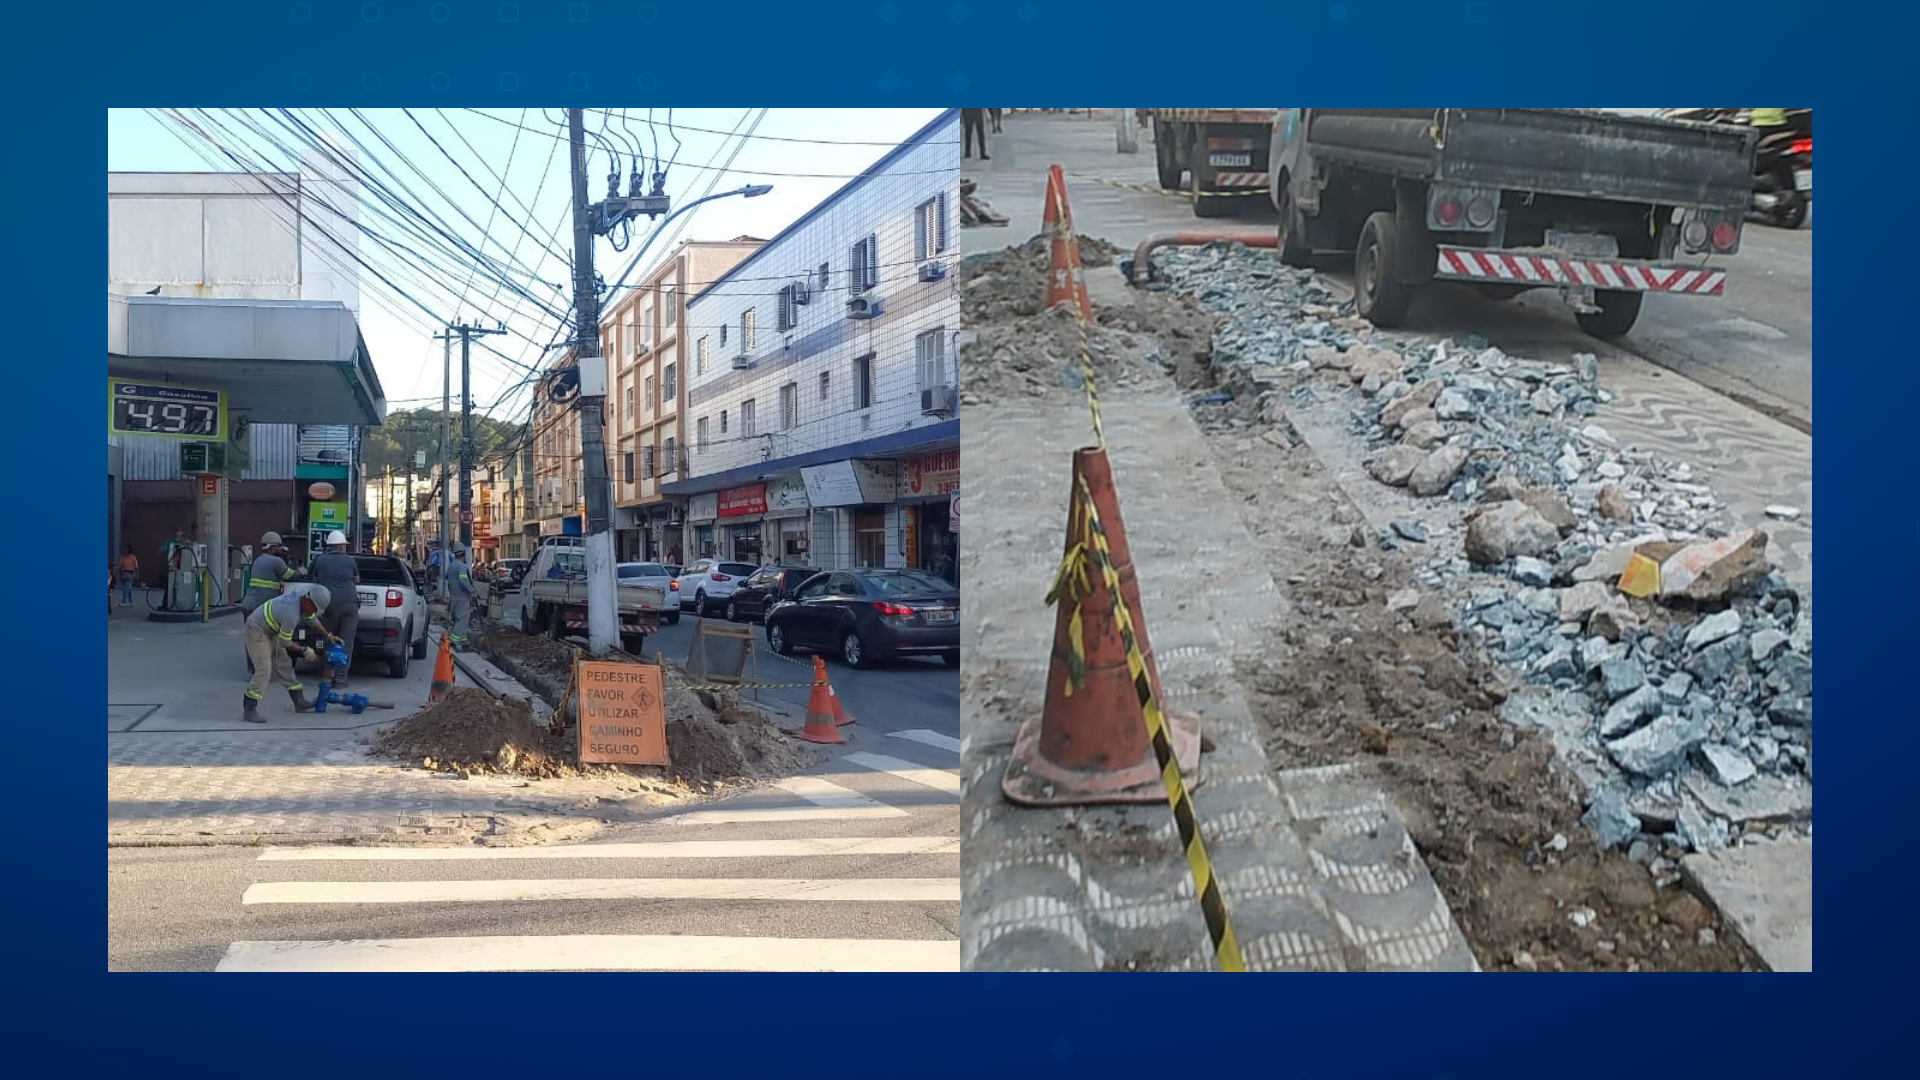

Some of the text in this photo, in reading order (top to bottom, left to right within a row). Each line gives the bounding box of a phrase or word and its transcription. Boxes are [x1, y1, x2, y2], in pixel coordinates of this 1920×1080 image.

[122, 385, 137, 394] G
[910, 456, 923, 494] 3
[204, 480, 215, 493] E
[586, 670, 646, 683] PEDESTRE
[587, 688, 625, 700] FAVOR
[588, 706, 639, 719] UTILIZAR
[589, 725, 643, 738] CAMINHO
[590, 743, 640, 756] SEGURO
